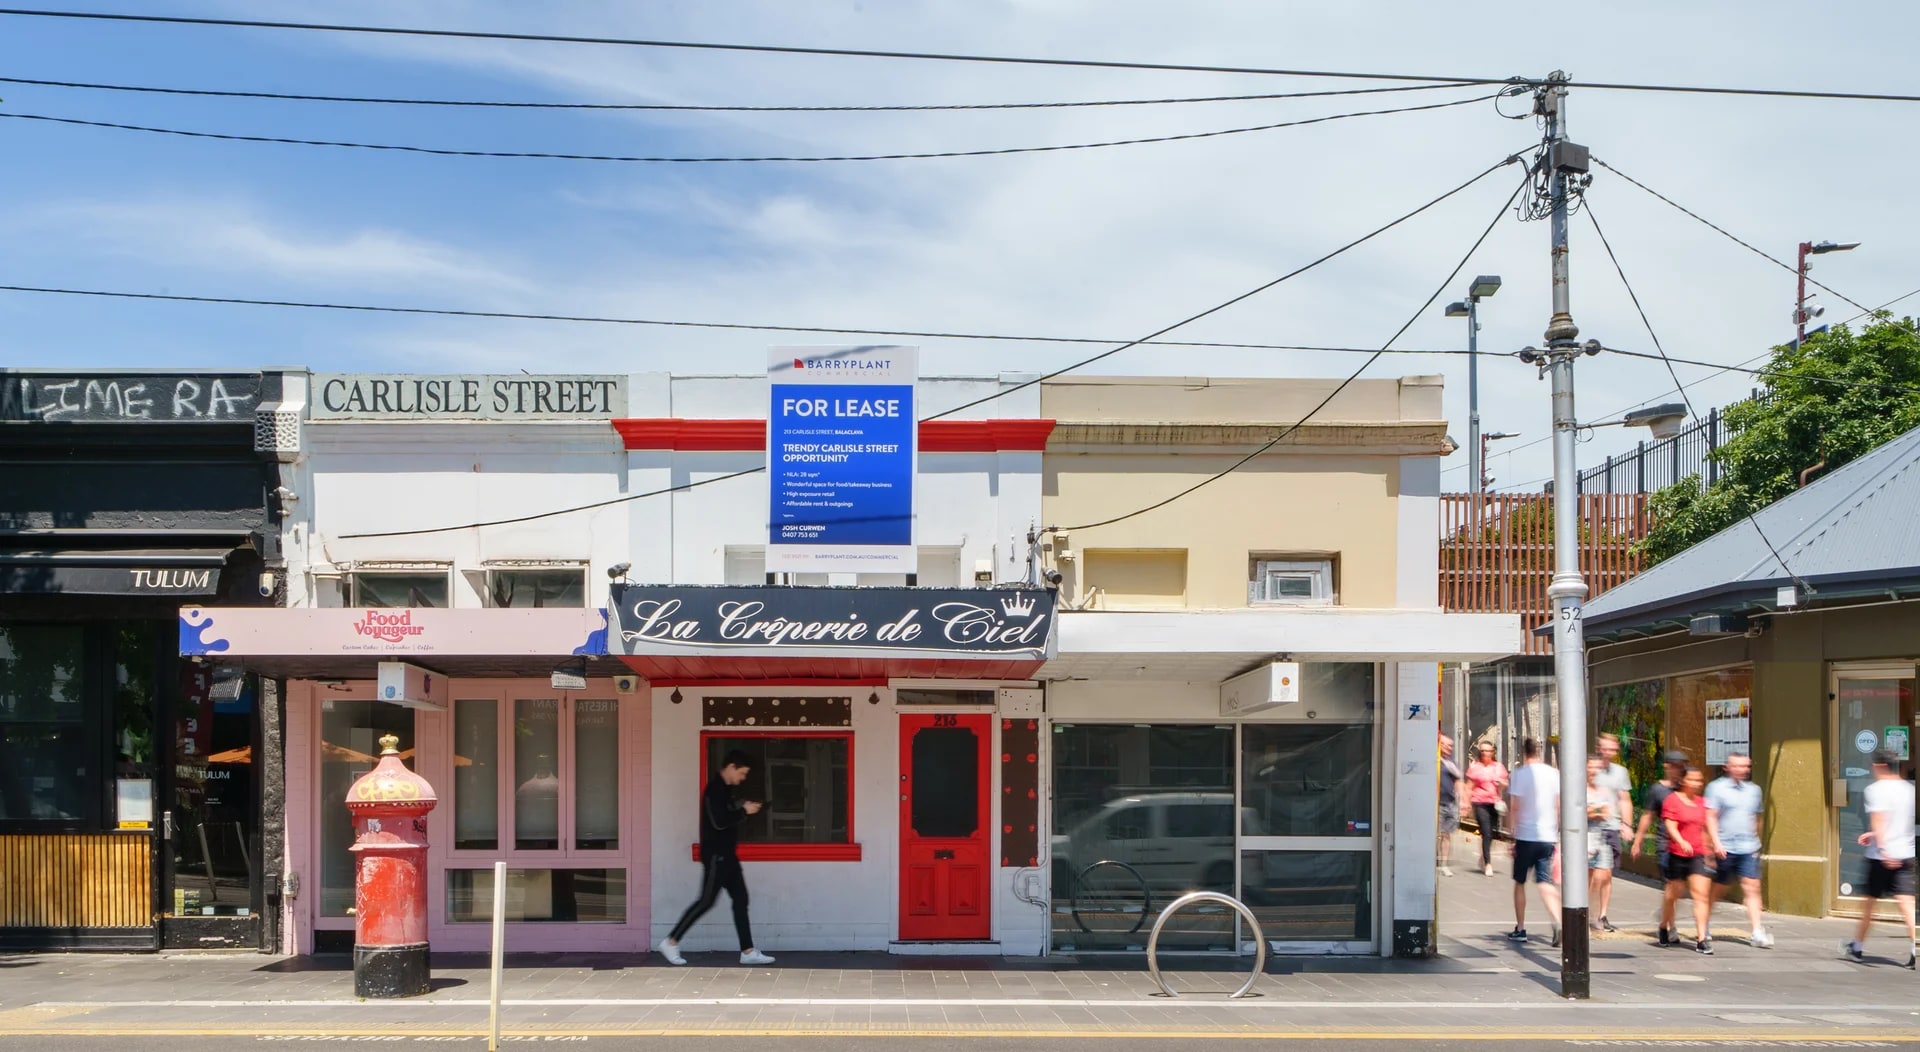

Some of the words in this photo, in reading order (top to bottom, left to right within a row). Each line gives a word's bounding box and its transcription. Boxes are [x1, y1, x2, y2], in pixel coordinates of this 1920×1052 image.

[808, 360, 891, 369] BARRYPLANT
[323, 379, 481, 413] CARLISLE
[493, 380, 617, 413] STREET
[783, 399, 828, 417] FOR
[835, 400, 899, 417] LEASE
[783, 444, 819, 453] TRENDY
[821, 444, 863, 453] CARLISLE
[865, 444, 899, 453] STREET
[783, 454, 849, 462] OPPORTUNITY
[130, 570, 209, 588] TULUM
[367, 610, 411, 626] Food
[1561, 607, 1581, 620] 52
[633, 599, 699, 639] La
[717, 601, 870, 645] Crêperie
[876, 609, 922, 641] de
[932, 601, 1046, 645] Ciel
[1567, 622, 1577, 633] A
[353, 619, 424, 643] Voyageur
[198, 770, 230, 779] TULUM
